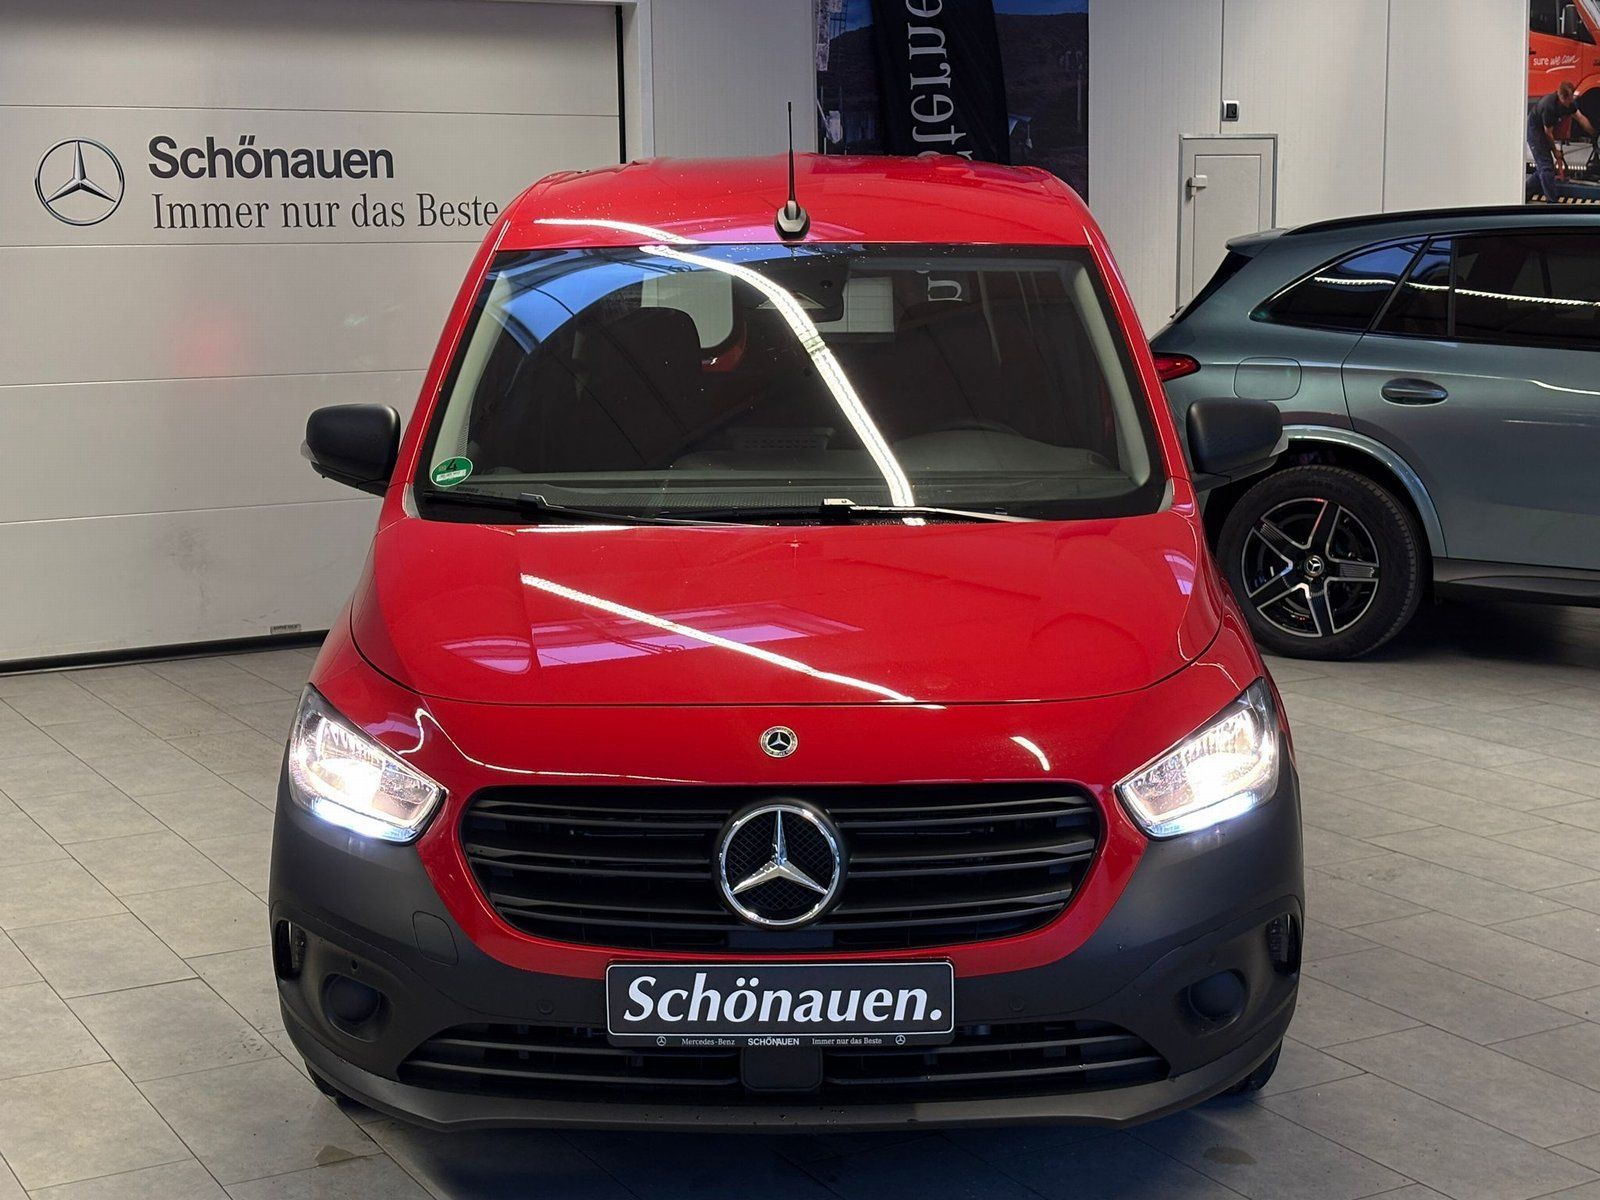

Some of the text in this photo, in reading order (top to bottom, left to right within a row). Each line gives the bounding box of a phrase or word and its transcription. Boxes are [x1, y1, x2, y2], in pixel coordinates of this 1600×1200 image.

[1533, 57, 1549, 66] sure
[1550, 56, 1561, 66] we
[148, 135, 394, 179] Schönauen
[151, 192, 499, 229] Immer nur das Beste
[445, 459, 457, 471] 4
[623, 972, 943, 1022] Schönauen.
[681, 1038, 736, 1046] Mercedes-Benz
[747, 1036, 800, 1046] SCHÖNAUEN
[850, 1037, 863, 1045] das
